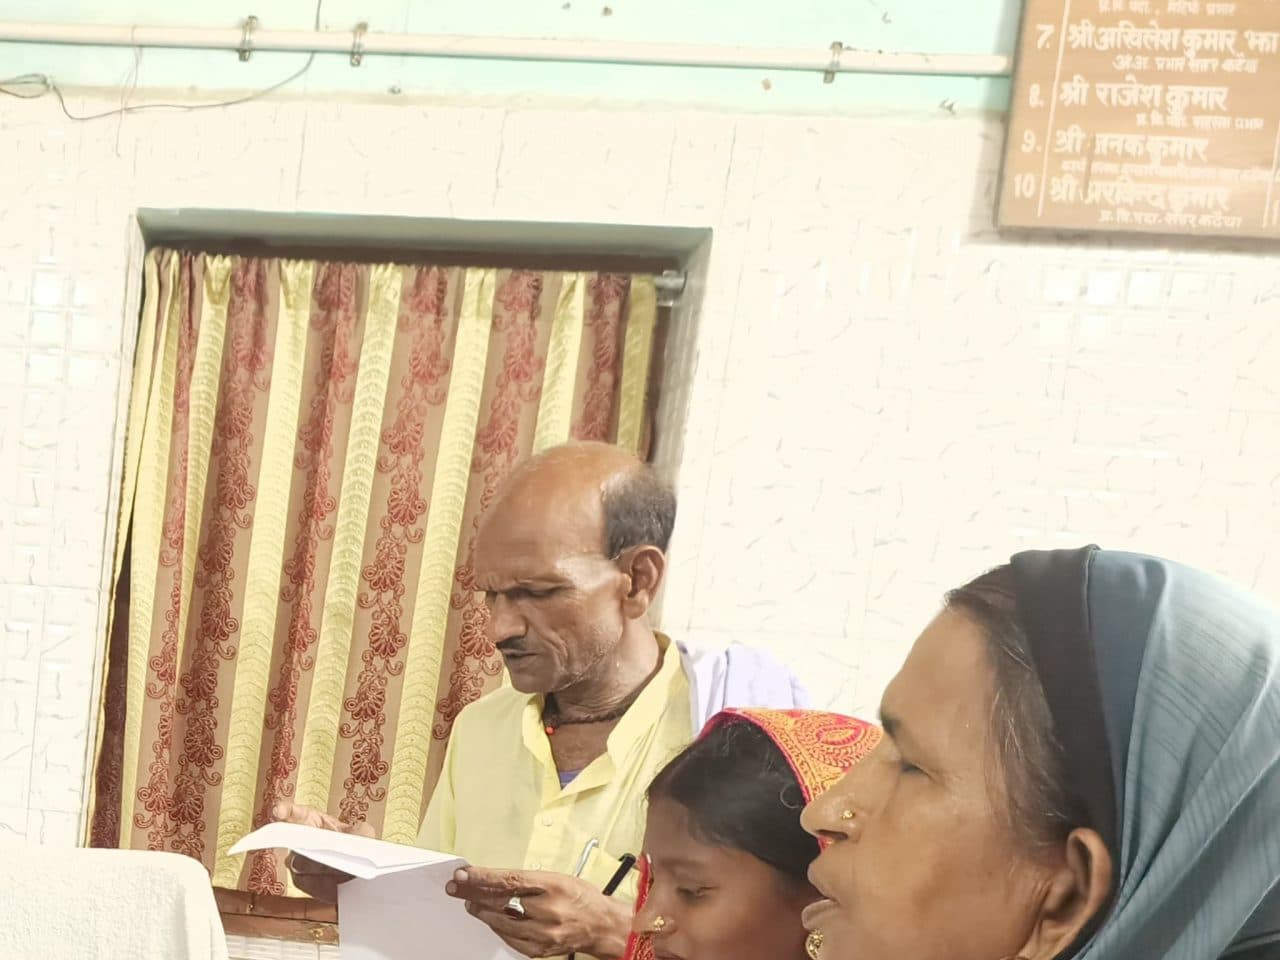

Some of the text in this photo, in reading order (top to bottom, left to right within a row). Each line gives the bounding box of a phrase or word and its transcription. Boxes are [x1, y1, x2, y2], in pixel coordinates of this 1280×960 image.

[1068, 19, 1095, 49] श्री
[1182, 29, 1238, 58] कुमार
[1059, 74, 1089, 106] श्री
[1095, 74, 1163, 108] राजेश
[1166, 85, 1229, 115] कुमार
[1054, 123, 1086, 153] श्री
[1013, 174, 1036, 199] 10
[1050, 175, 1078, 202] श्री
